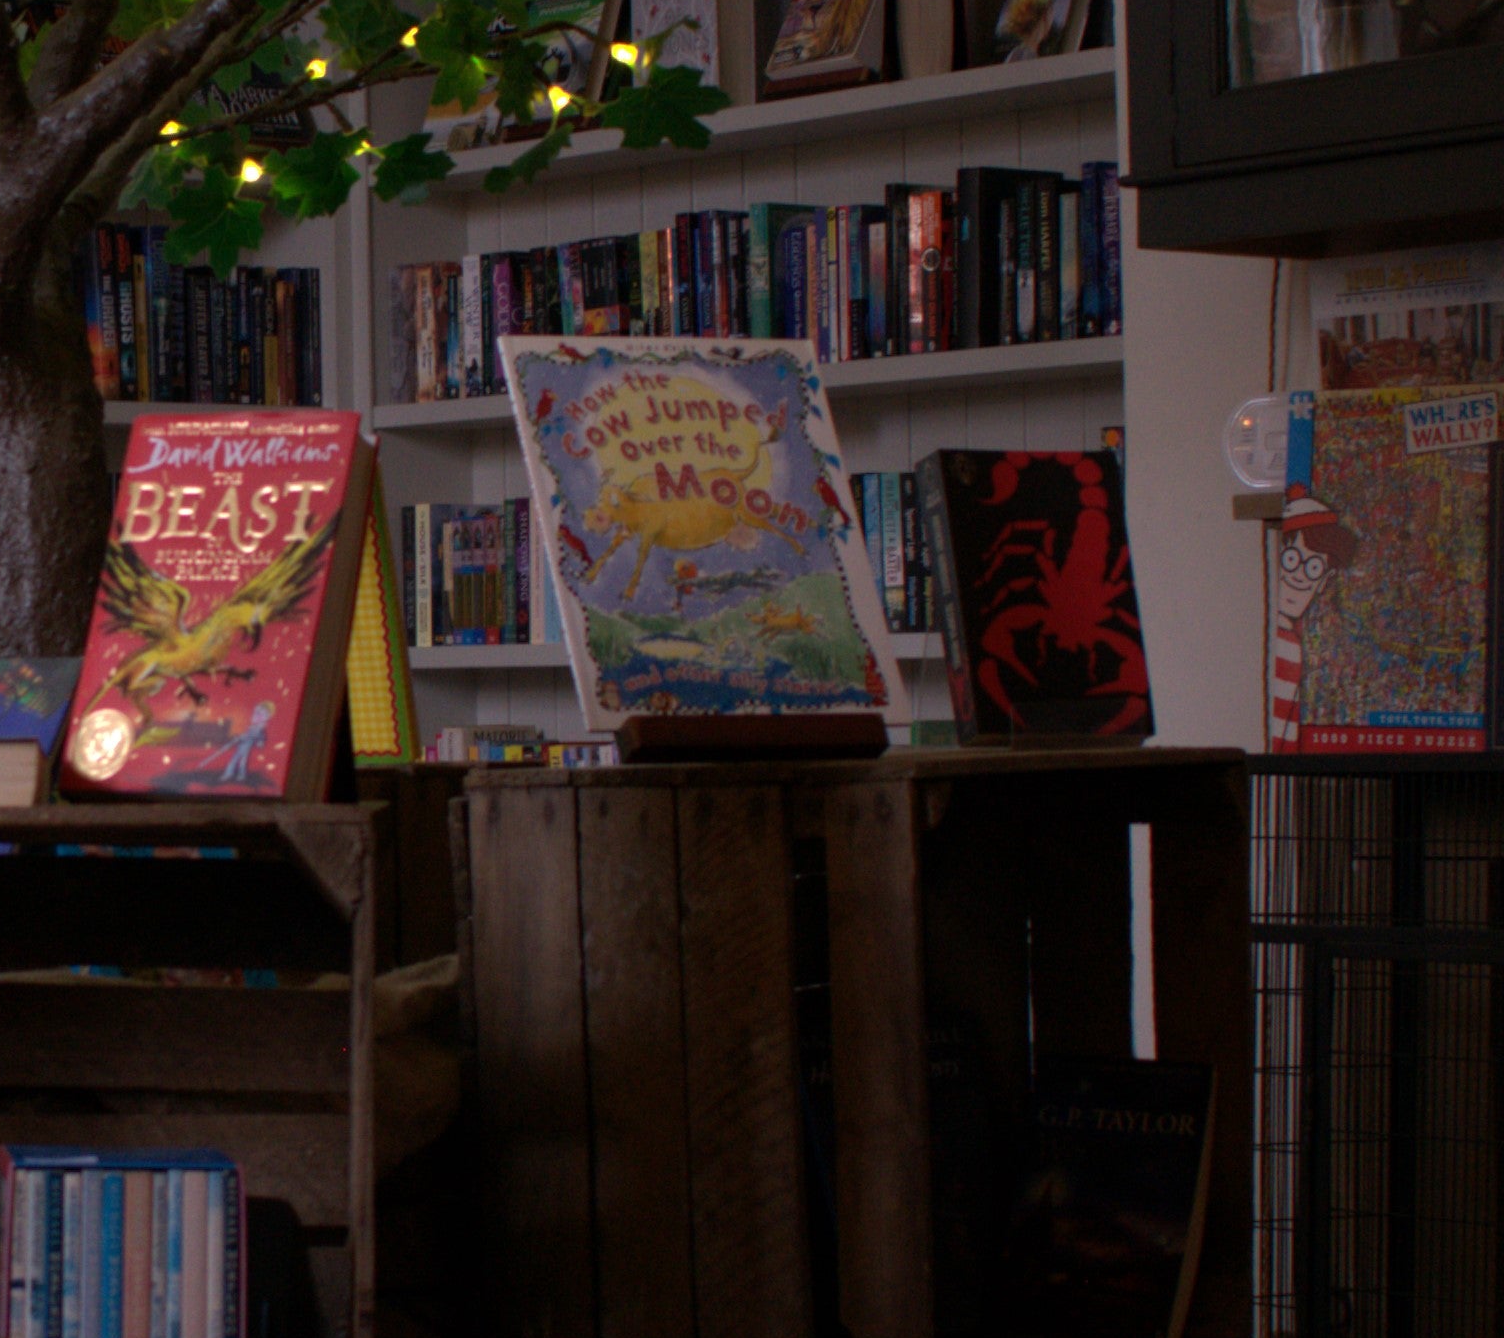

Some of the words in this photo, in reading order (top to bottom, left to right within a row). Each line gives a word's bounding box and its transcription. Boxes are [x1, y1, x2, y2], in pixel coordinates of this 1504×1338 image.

[102, 294, 116, 348] DRIVER
[120, 280, 135, 345] GHOSTS
[563, 382, 618, 423] How
[623, 369, 671, 395] the
[1409, 398, 1496, 427] WHRE'S
[563, 411, 630, 459] Cow
[644, 394, 789, 432] Jumped
[621, 432, 687, 462] over
[694, 430, 744, 461] the
[1411, 418, 1495, 448] WALLY?
[127, 435, 222, 474] David
[224, 435, 340, 469] Walliams
[120, 477, 335, 553] BEAST
[655, 462, 811, 533] Moon
[887, 547, 899, 584] BAXTER
[1312, 732, 1349, 744] 1000
[1356, 733, 1405, 746] PIECE
[1414, 734, 1477, 748] PUZZLE
[1092, 1108, 1197, 1136] TAYLOR
